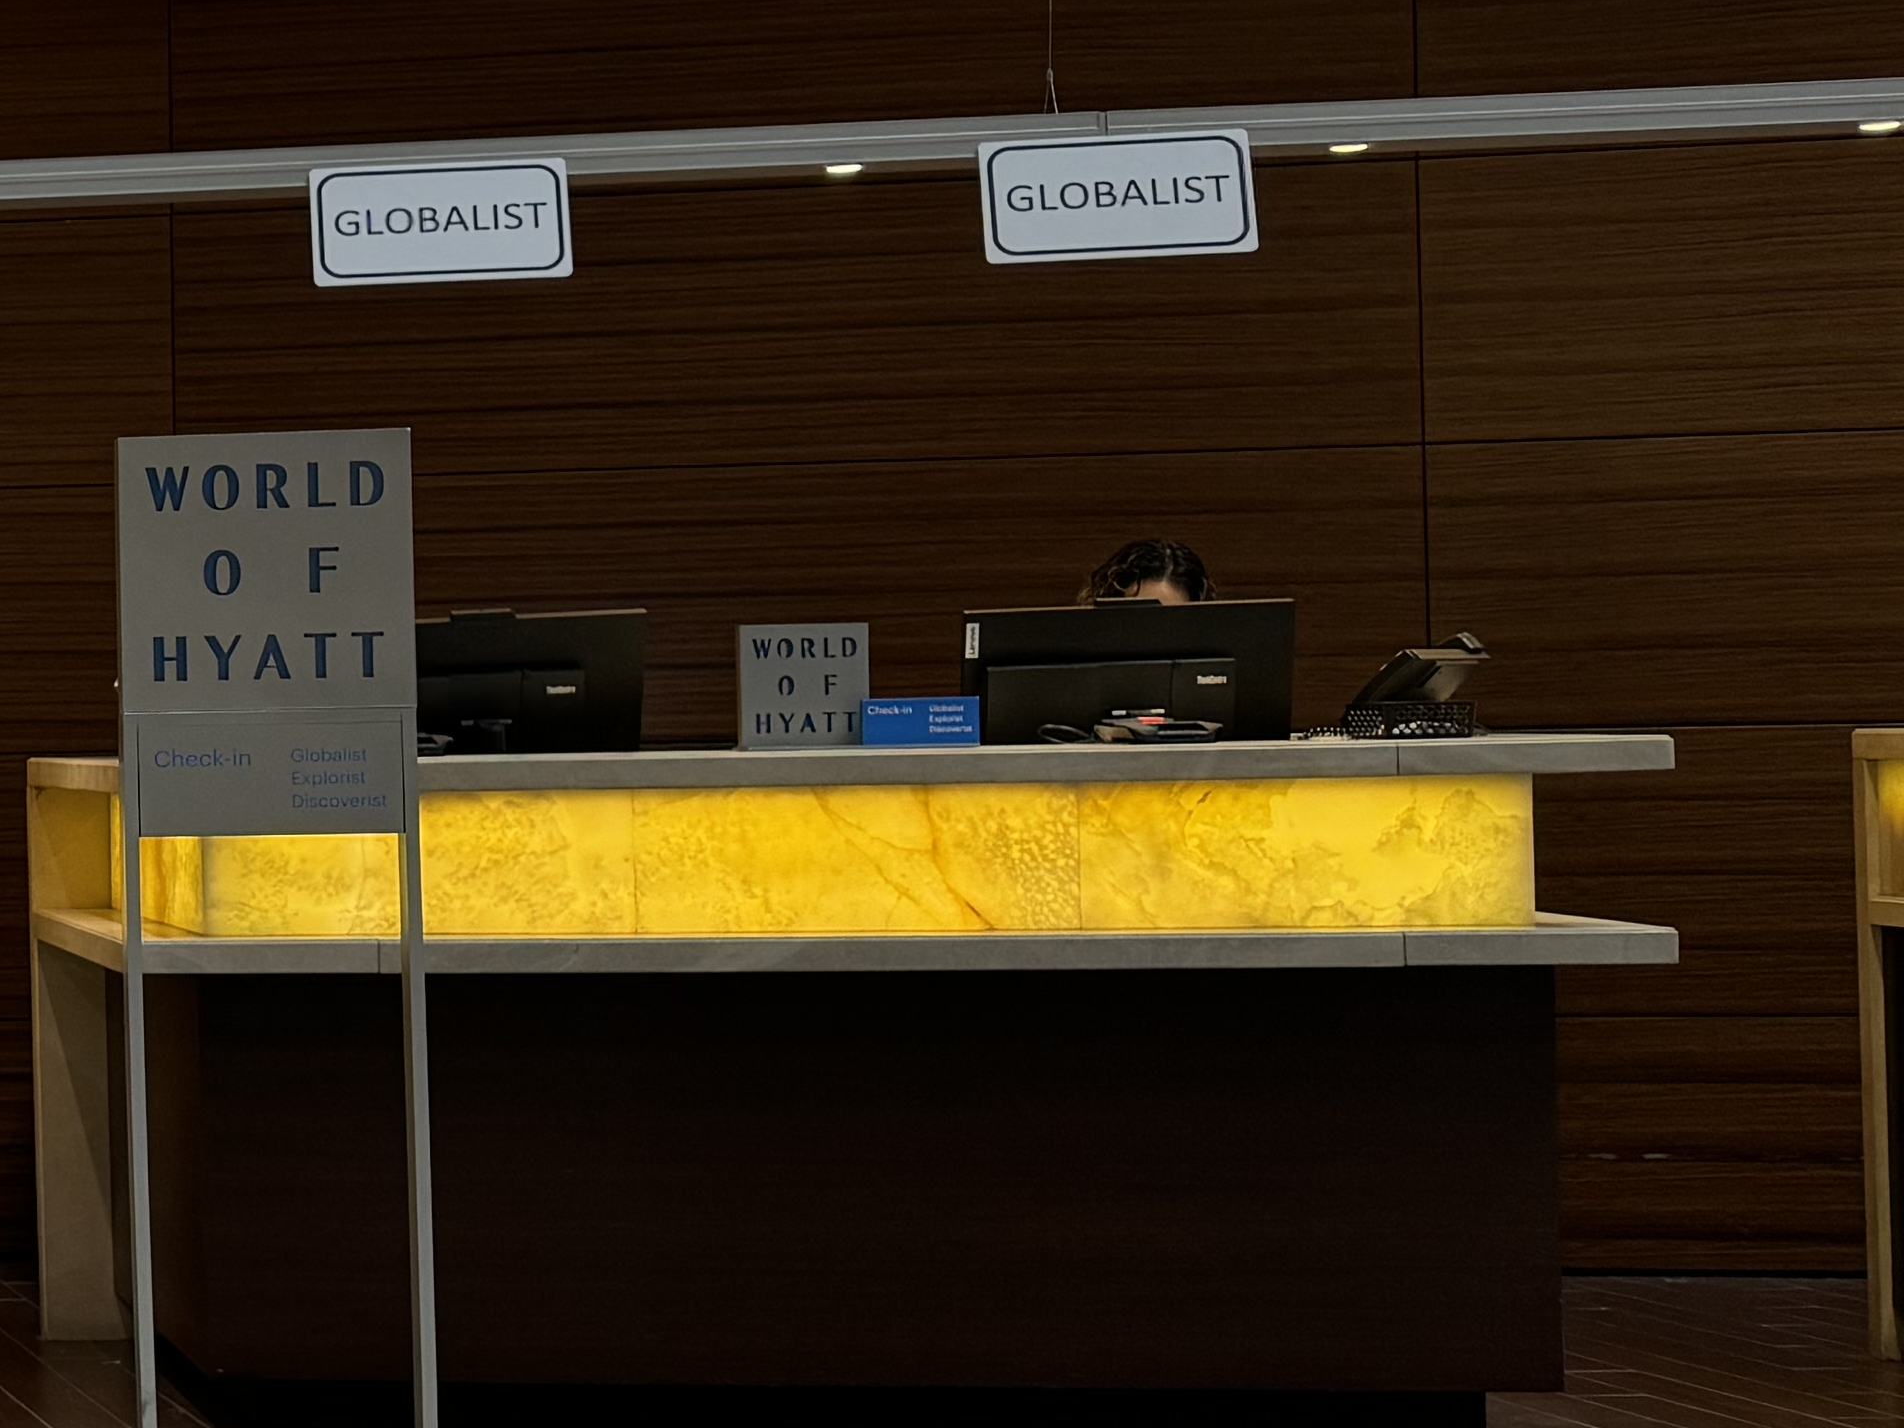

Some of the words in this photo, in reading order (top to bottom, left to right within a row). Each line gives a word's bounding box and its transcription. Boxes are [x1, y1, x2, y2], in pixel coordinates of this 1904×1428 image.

[1005, 175, 1230, 214] GLOBALIST
[333, 202, 548, 239] GLOBALIST
[144, 460, 385, 512] WORLD
[152, 631, 385, 682] HYATT
[752, 636, 858, 659] WORLD
[867, 704, 913, 715] Check-in
[755, 710, 857, 734] HYATT
[153, 747, 252, 769] Check-in
[291, 747, 367, 763] Globalist
[291, 770, 366, 787] Explorist
[291, 793, 387, 809] Discoverist
